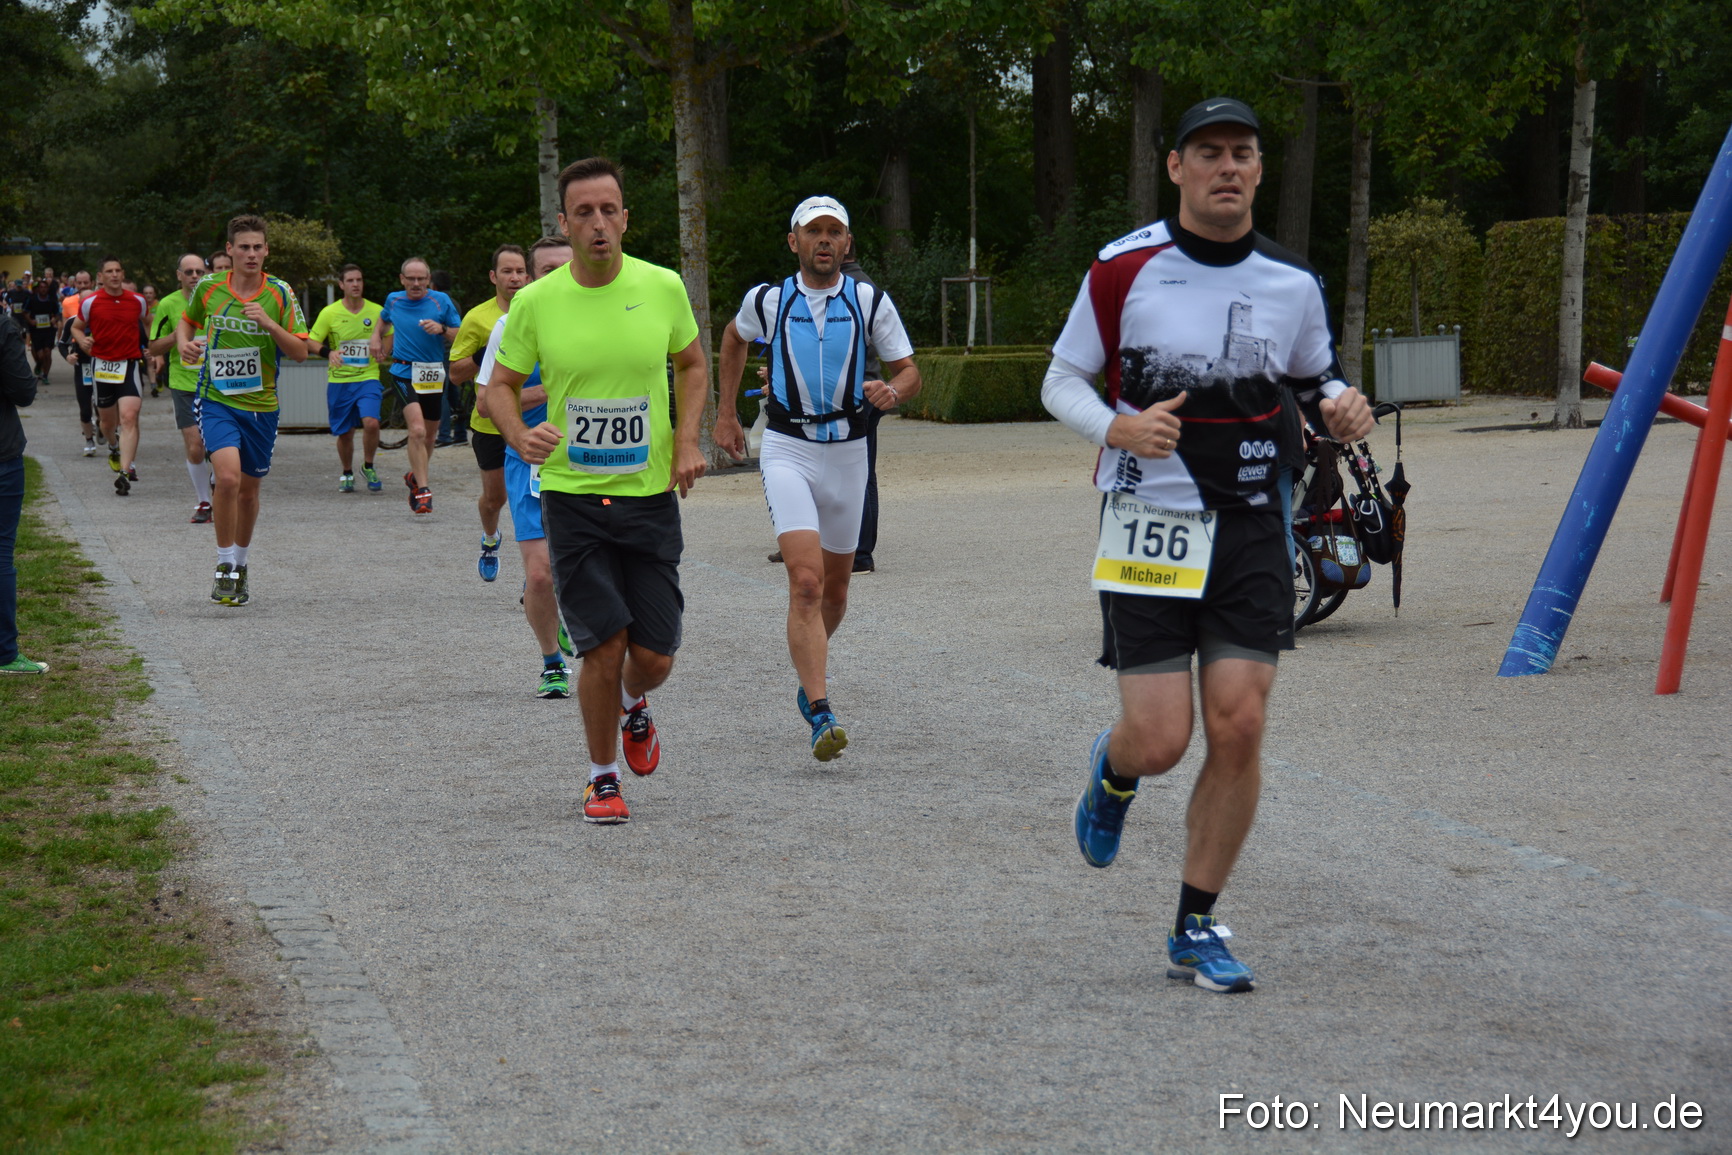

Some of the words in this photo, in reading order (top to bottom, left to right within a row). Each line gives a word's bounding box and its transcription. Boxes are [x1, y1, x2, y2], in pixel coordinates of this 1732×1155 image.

[342, 345, 368, 356] 2671
[100, 361, 120, 374] 302
[215, 358, 257, 377] 2826
[419, 370, 439, 382] 365
[226, 381, 247, 389] Lukas
[567, 403, 597, 413] PARTL
[597, 405, 637, 414] Neumarkt
[575, 415, 644, 445] 2780
[583, 451, 636, 466] Benjamin
[1108, 501, 1140, 513] PARTL
[1143, 504, 1196, 521] Neumarkt
[1122, 518, 1190, 561] 156
[1120, 565, 1178, 585] Michael
